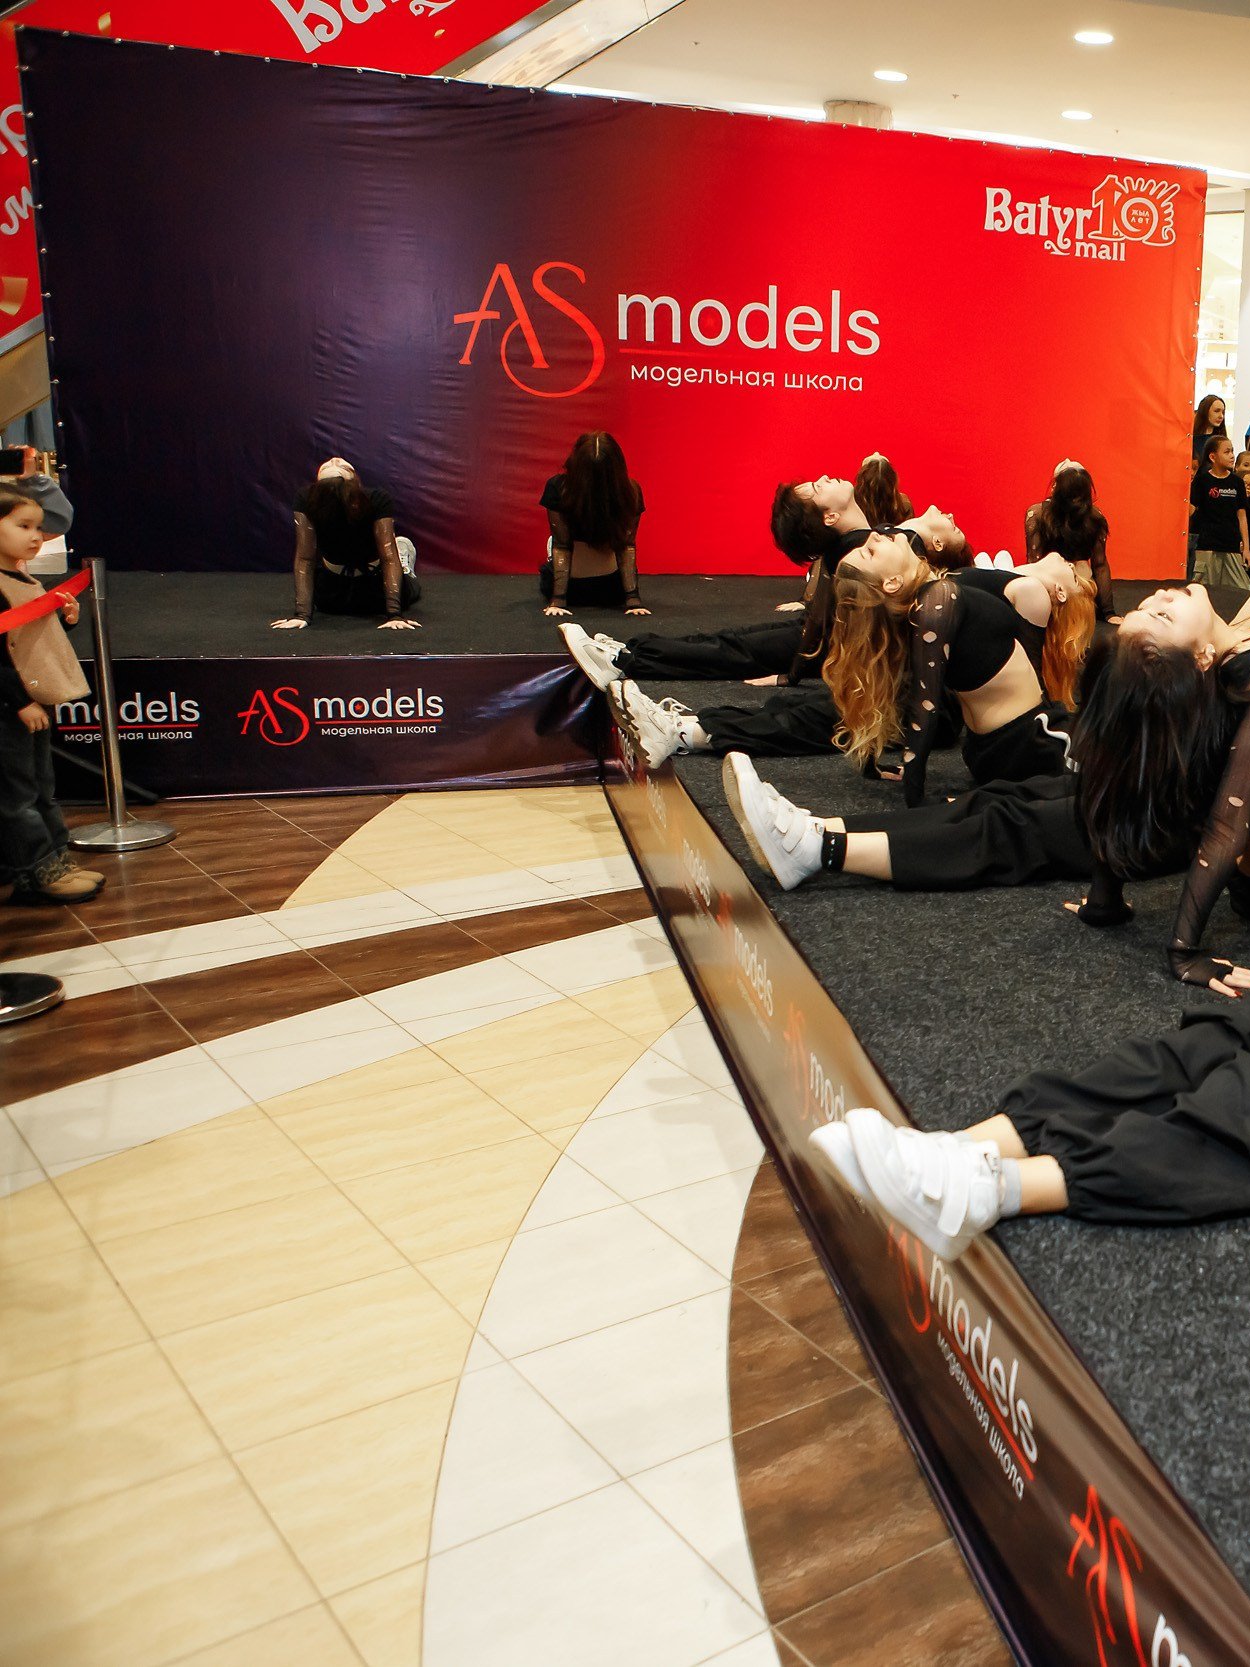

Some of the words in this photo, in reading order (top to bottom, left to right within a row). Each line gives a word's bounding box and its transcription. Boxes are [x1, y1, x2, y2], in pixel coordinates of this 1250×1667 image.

[984, 187, 1092, 256] Batyr
[1074, 240, 1126, 262] mall
[453, 261, 606, 398] AS
[617, 284, 882, 356] models
[631, 363, 776, 387] модельная
[783, 371, 864, 392] школа
[55, 691, 200, 725] mdels
[64, 730, 144, 744] моденая
[147, 730, 193, 741] школа
[237, 686, 310, 746] AS
[313, 687, 445, 719] models
[321, 726, 393, 738] модельная
[396, 724, 437, 735] школа
[734, 926, 774, 1018] models
[930, 1253, 1038, 1464] models
[937, 1329, 990, 1434] модельная
[988, 1428, 1025, 1501] школа
